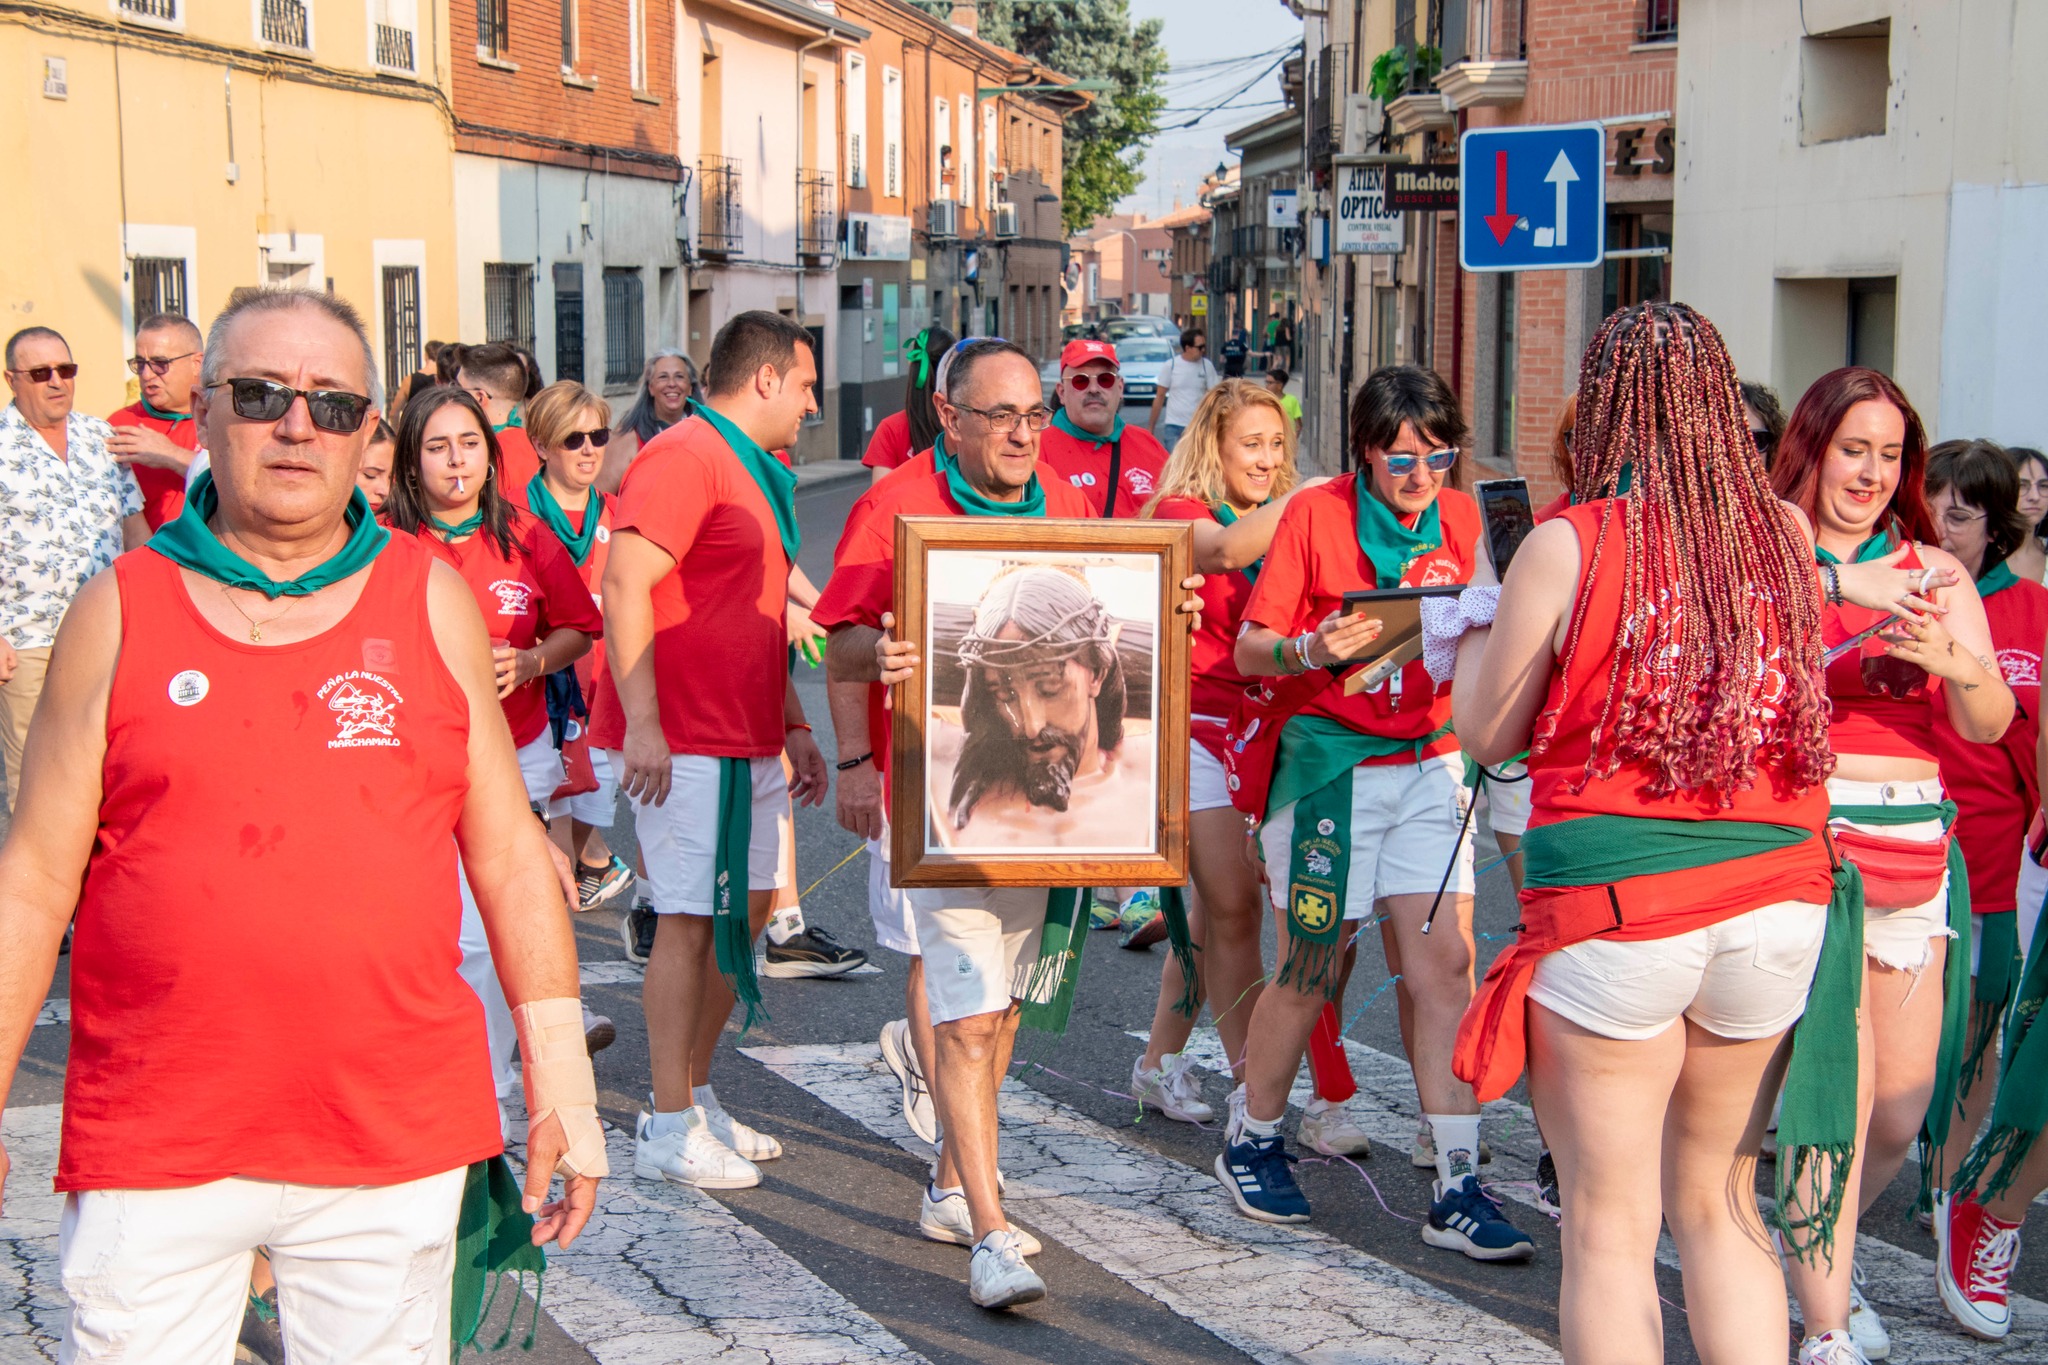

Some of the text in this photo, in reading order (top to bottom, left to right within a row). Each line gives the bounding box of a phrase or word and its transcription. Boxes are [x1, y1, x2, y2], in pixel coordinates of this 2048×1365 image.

[1348, 168, 1385, 191] ATIEN
[1395, 194, 1460, 203] DESDE 189
[1347, 223, 1392, 232] CONTROL VISUAL
[1341, 242, 1399, 252] LENTES DE CONTACTO
[316, 670, 404, 704] PEÑA LA NUESTRA
[327, 737, 401, 749] MARCHAMALO
